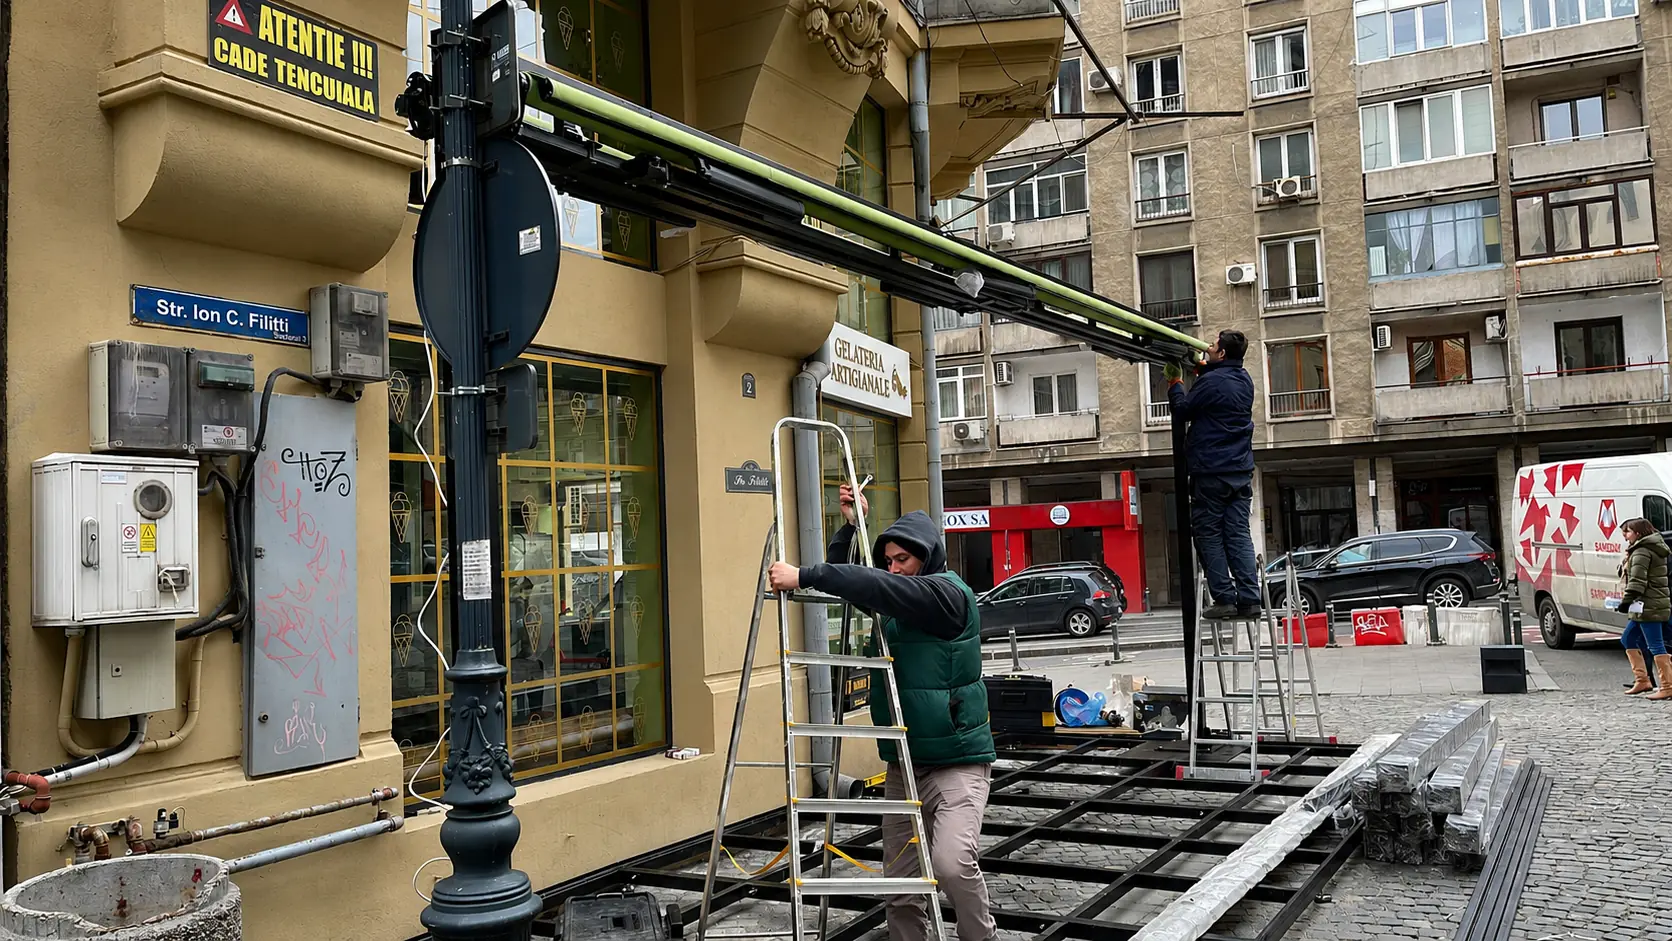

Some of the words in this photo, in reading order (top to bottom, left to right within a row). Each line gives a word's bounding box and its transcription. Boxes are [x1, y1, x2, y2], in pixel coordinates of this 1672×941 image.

[258, 4, 346, 70] ATENTIE
[352, 39, 373, 80] !!!
[213, 37, 269, 78] CADE
[273, 58, 375, 115] TENCUIALA
[157, 299, 187, 318] Str.
[193, 304, 221, 323] Ion
[226, 309, 244, 326] C.
[250, 313, 289, 333] Filitti
[834, 337, 885, 373] GELATERIA
[746, 381, 753, 394] 2
[830, 362, 890, 398] ARTIGIANALE
[944, 514, 967, 526] OX
[970, 513, 988, 525] SA
